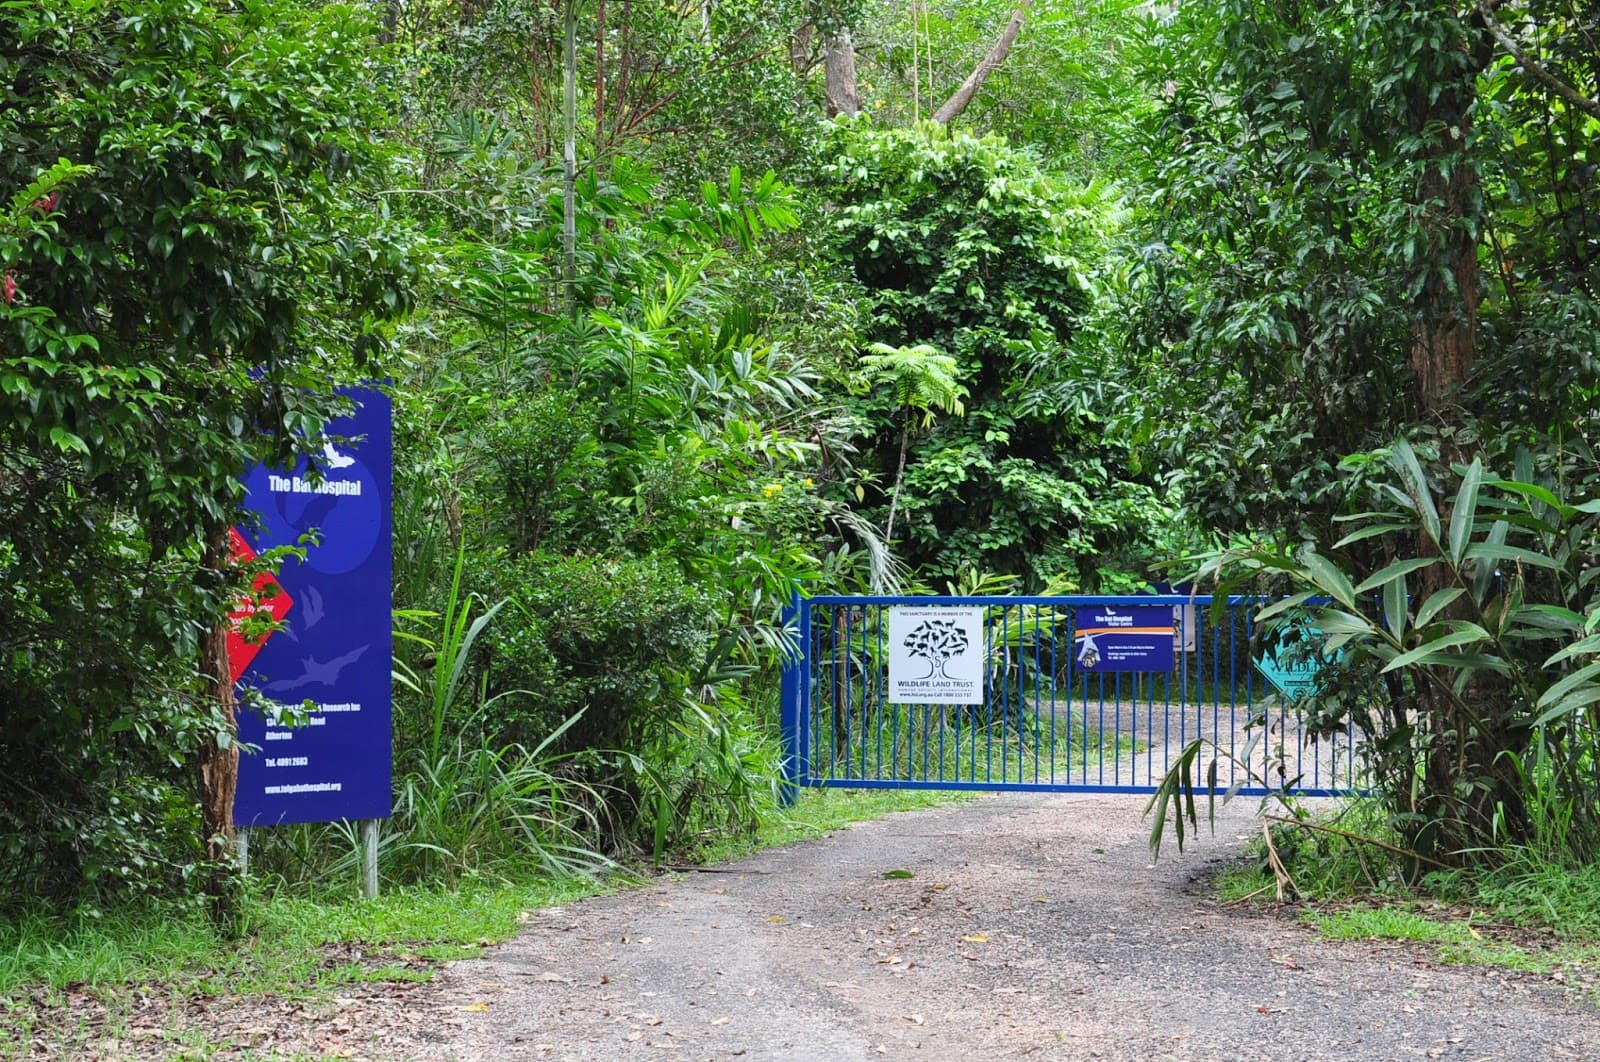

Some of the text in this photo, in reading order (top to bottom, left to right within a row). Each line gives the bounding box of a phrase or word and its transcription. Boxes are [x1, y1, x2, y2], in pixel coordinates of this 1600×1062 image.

[268, 475, 291, 492] The
[322, 703, 350, 712] Research
[350, 702, 360, 712] Inc
[310, 717, 326, 726] Road
[265, 731, 293, 740] Atherton
[276, 757, 291, 767] 4091
